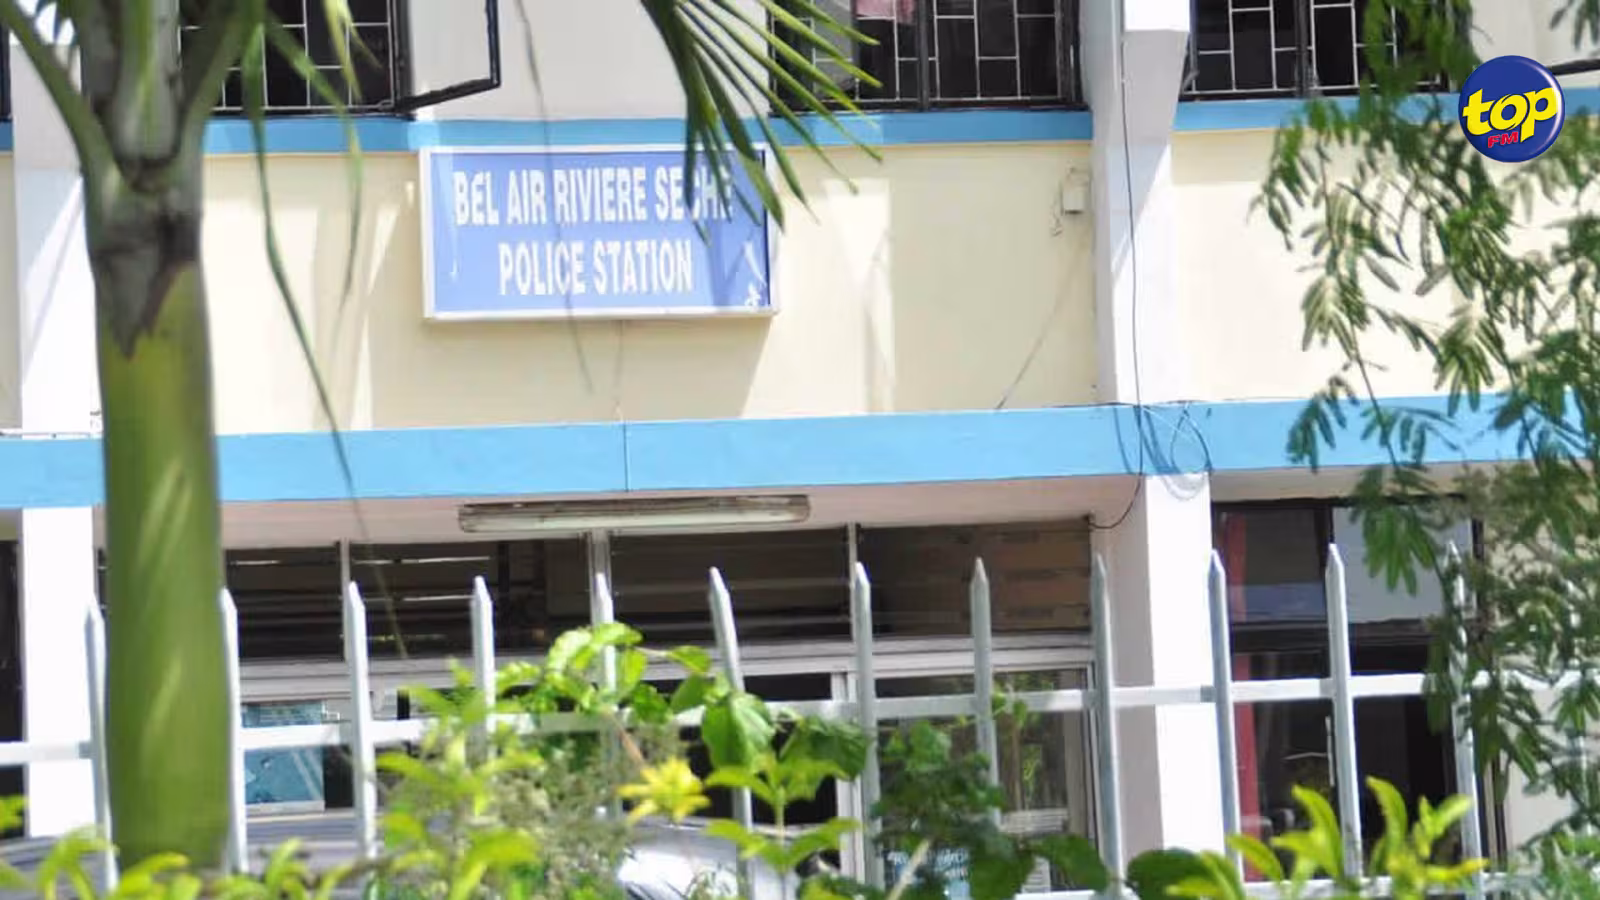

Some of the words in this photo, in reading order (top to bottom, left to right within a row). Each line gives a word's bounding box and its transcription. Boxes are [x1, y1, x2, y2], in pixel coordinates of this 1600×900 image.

[453, 170, 499, 226] BEL
[507, 168, 547, 225] AIR
[553, 166, 647, 225] RIVIERE
[498, 241, 586, 296] POLICE
[592, 239, 692, 295] STATION
